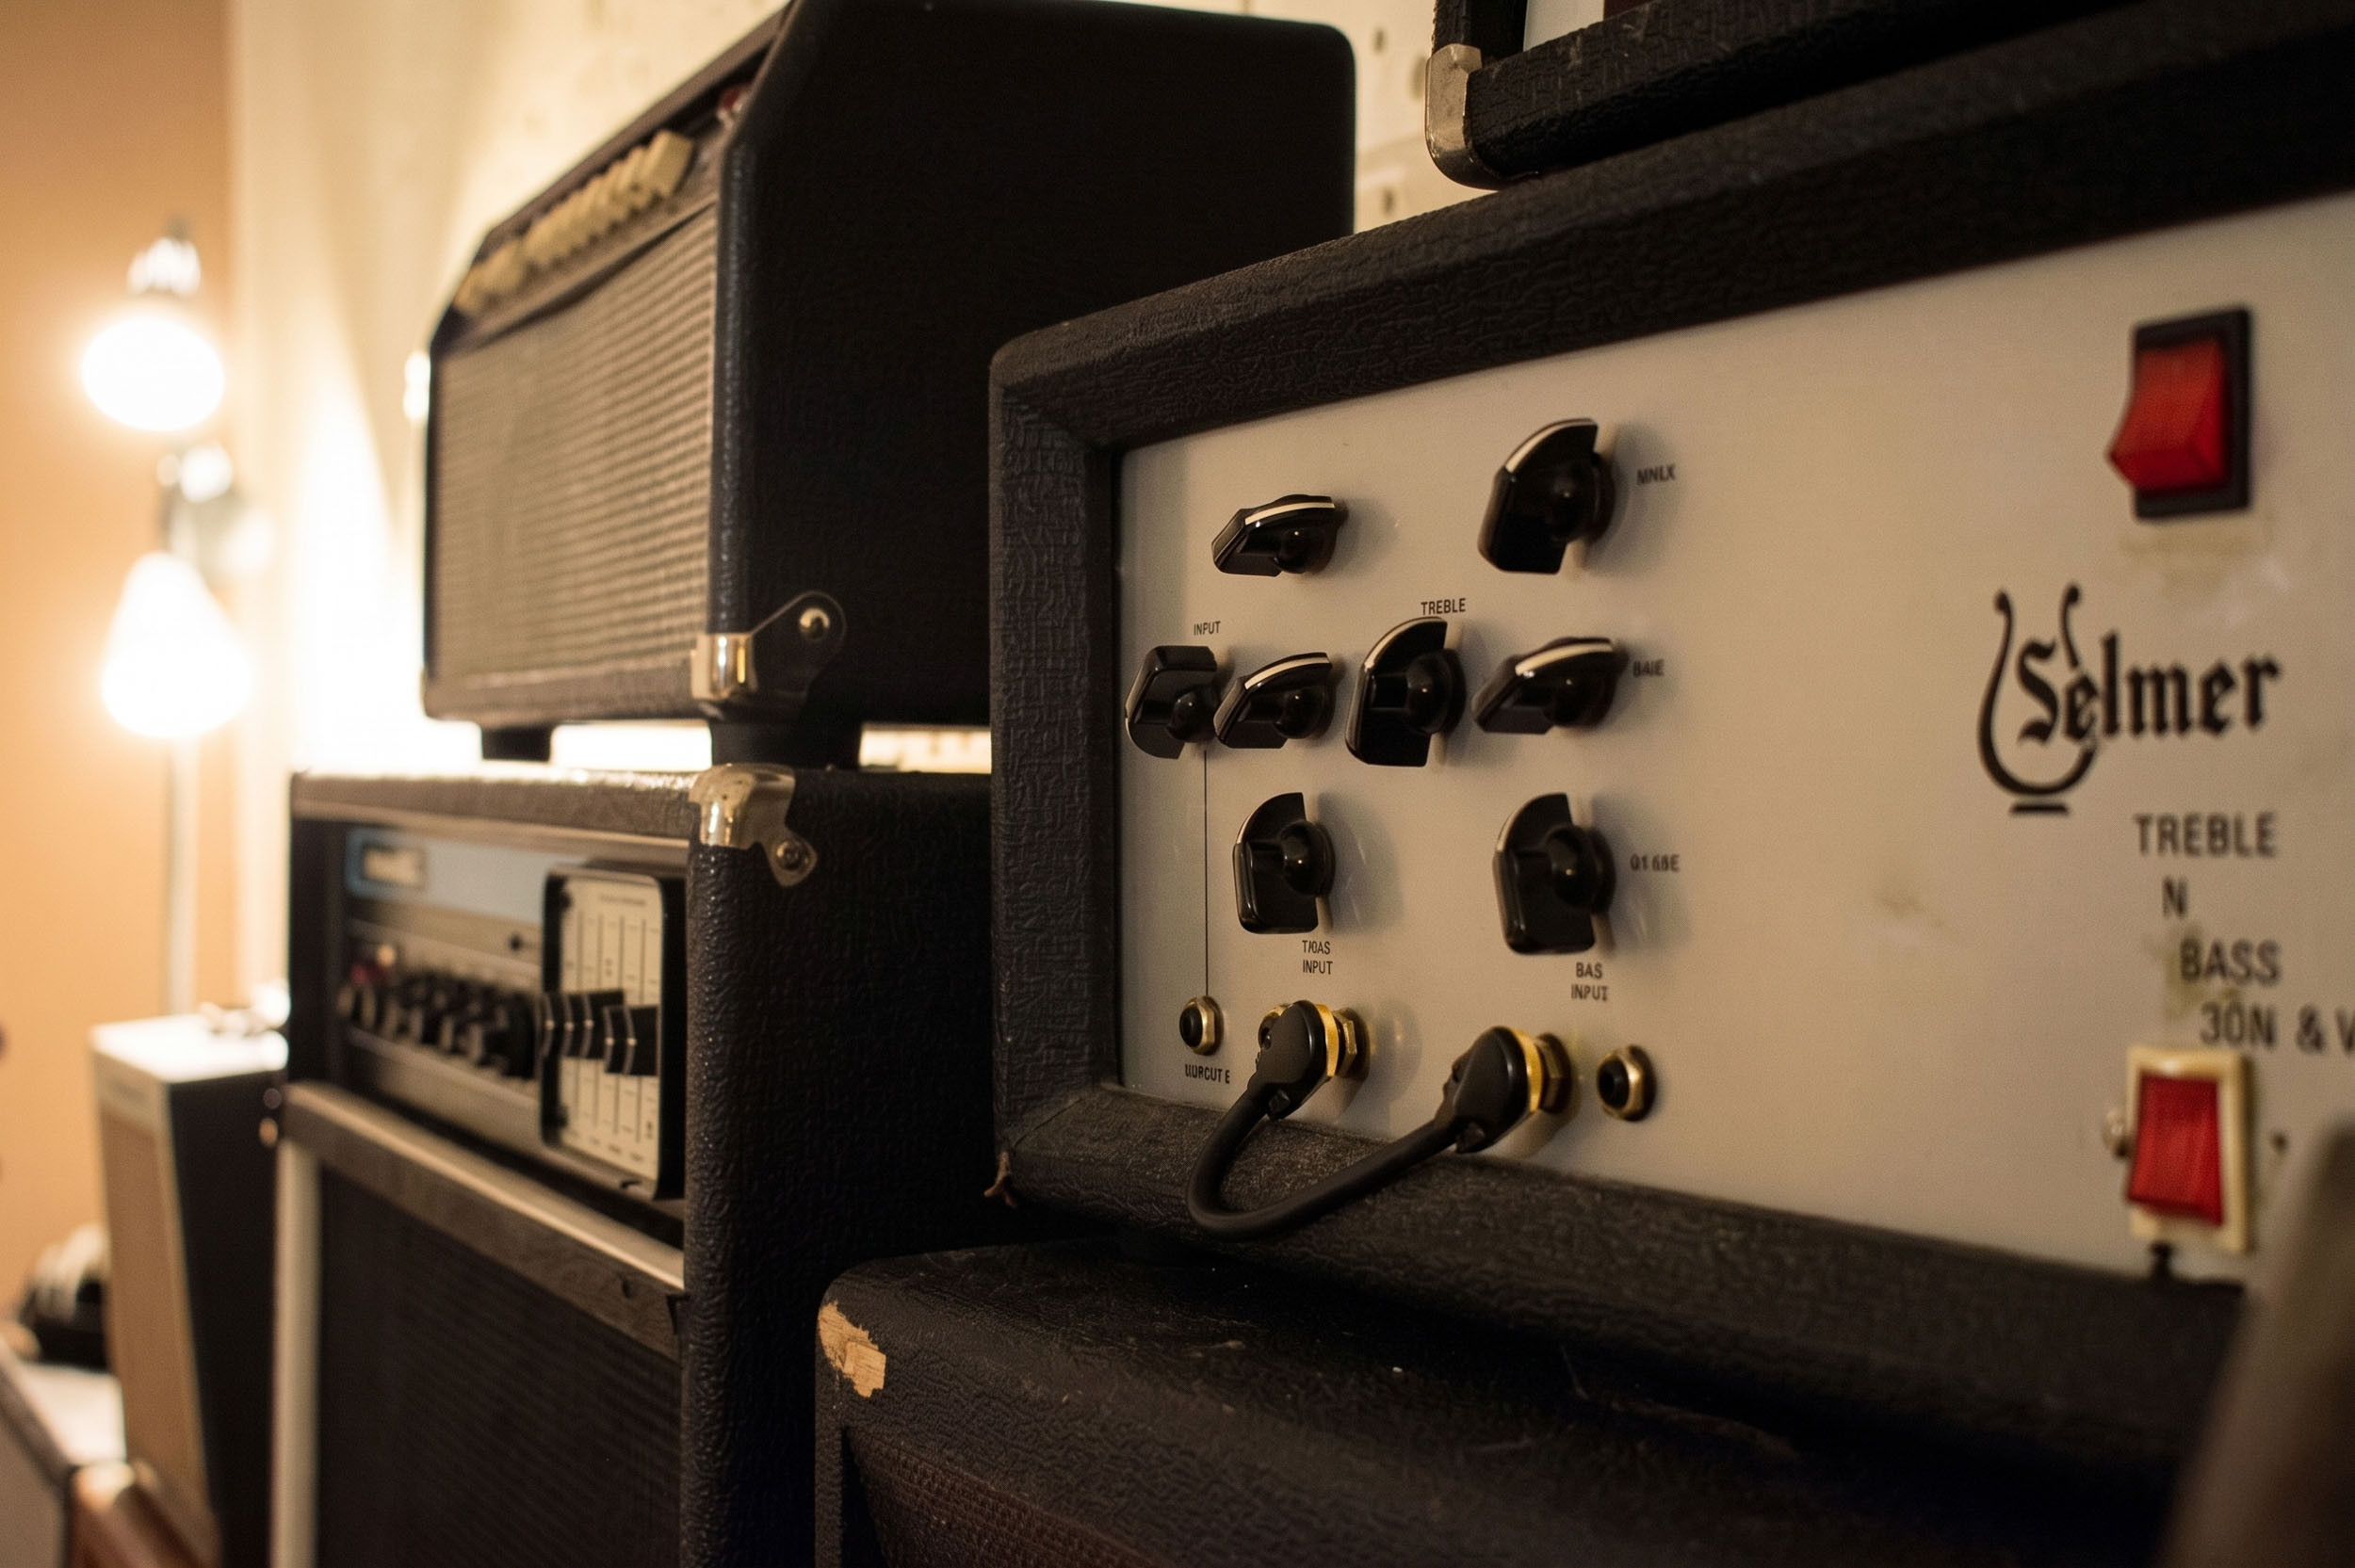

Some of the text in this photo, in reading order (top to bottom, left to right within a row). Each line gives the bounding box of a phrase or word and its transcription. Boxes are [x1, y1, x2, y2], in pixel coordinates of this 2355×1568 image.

[1421, 597, 1467, 616] TREBLE
[1194, 620, 1221, 636] INPUT
[2015, 629, 2283, 747] Selmer
[2134, 811, 2277, 859] TREBLE
[2163, 876, 2186, 917] N
[1302, 959, 1334, 975] INPUT
[1575, 962, 1603, 979] BAS
[2179, 938, 2281, 986] BASS
[1570, 983, 1608, 1002] INPUT
